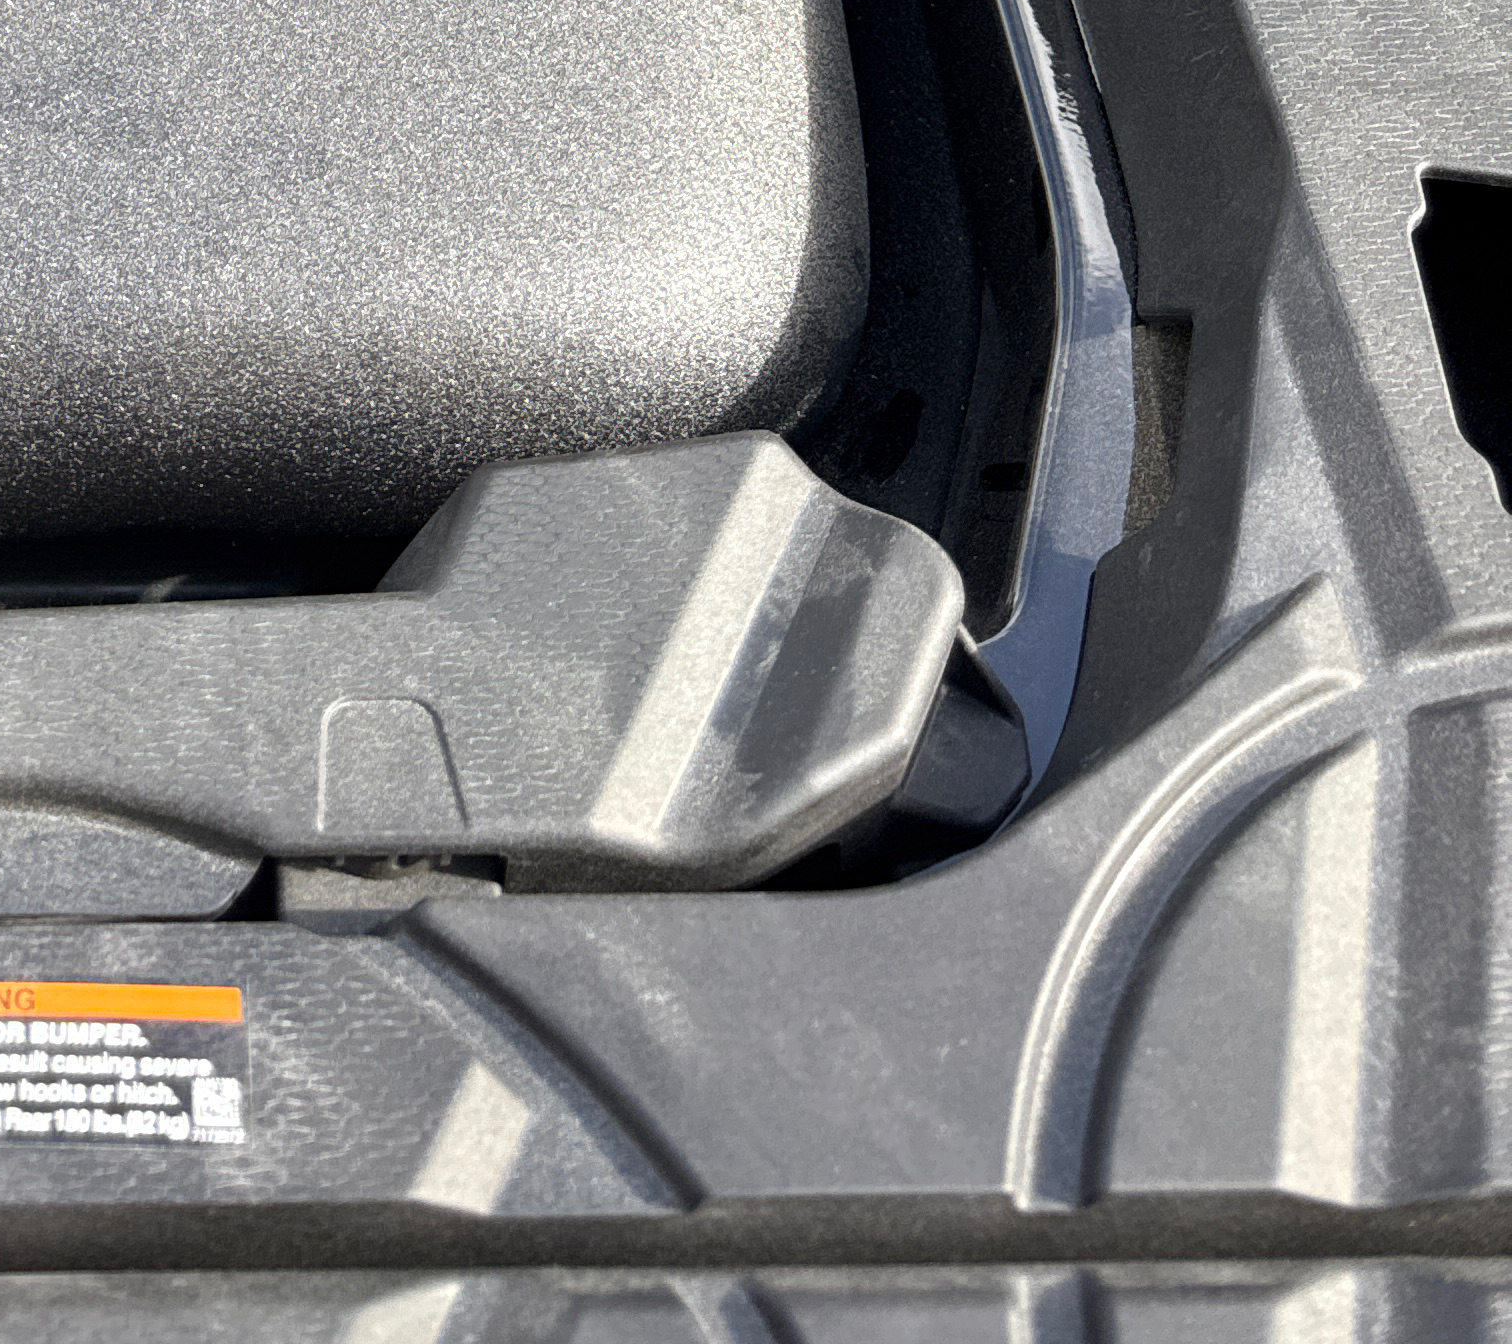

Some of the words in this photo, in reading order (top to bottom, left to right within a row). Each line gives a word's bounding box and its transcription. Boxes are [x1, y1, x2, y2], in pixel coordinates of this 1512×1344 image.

[29, 1022, 145, 1047] BUMPER.
[50, 1052, 136, 1080] causing
[138, 1058, 212, 1082] severe
[17, 1079, 87, 1103] hooks
[88, 1085, 114, 1104] or
[115, 1081, 175, 1105] hitch.
